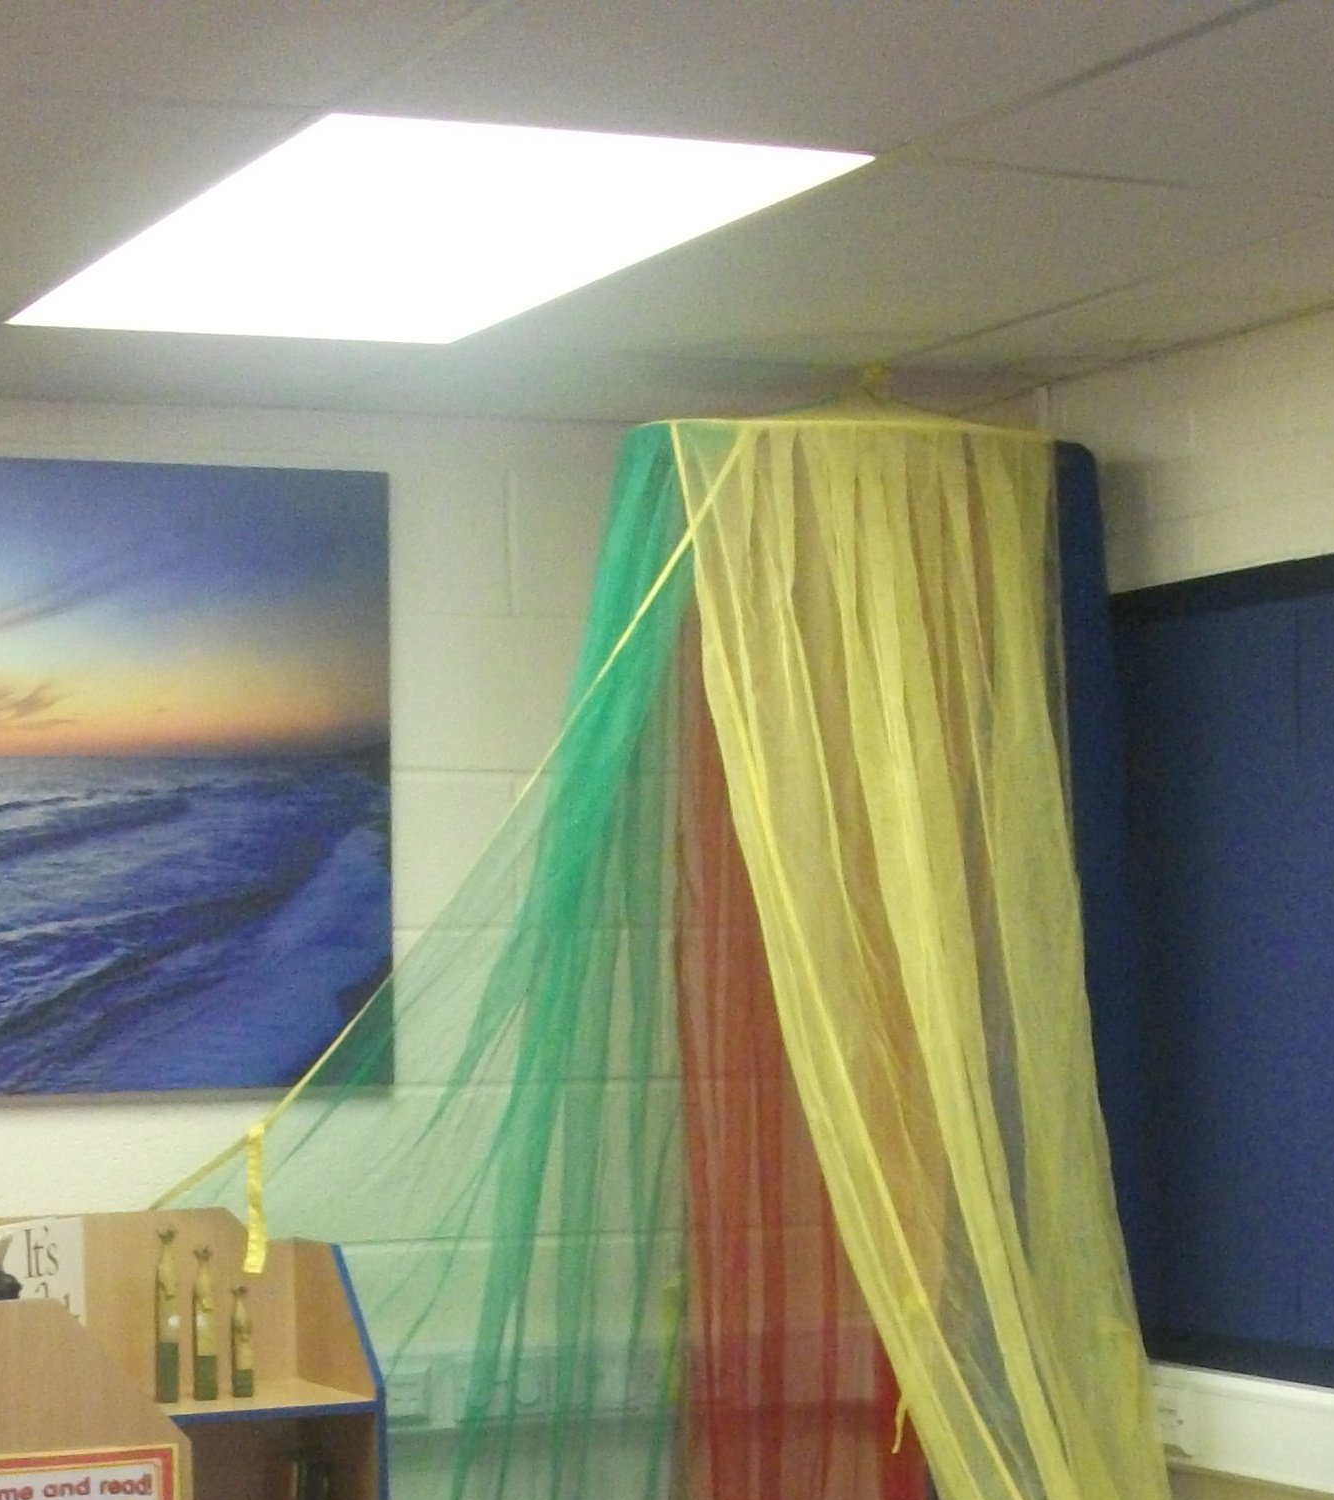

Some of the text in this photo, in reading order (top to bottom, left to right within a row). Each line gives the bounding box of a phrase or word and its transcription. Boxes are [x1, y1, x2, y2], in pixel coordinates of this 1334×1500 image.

[24, 1226, 60, 1279] It's
[43, 1476, 92, 1499] and
[99, 1473, 153, 1497] read!
